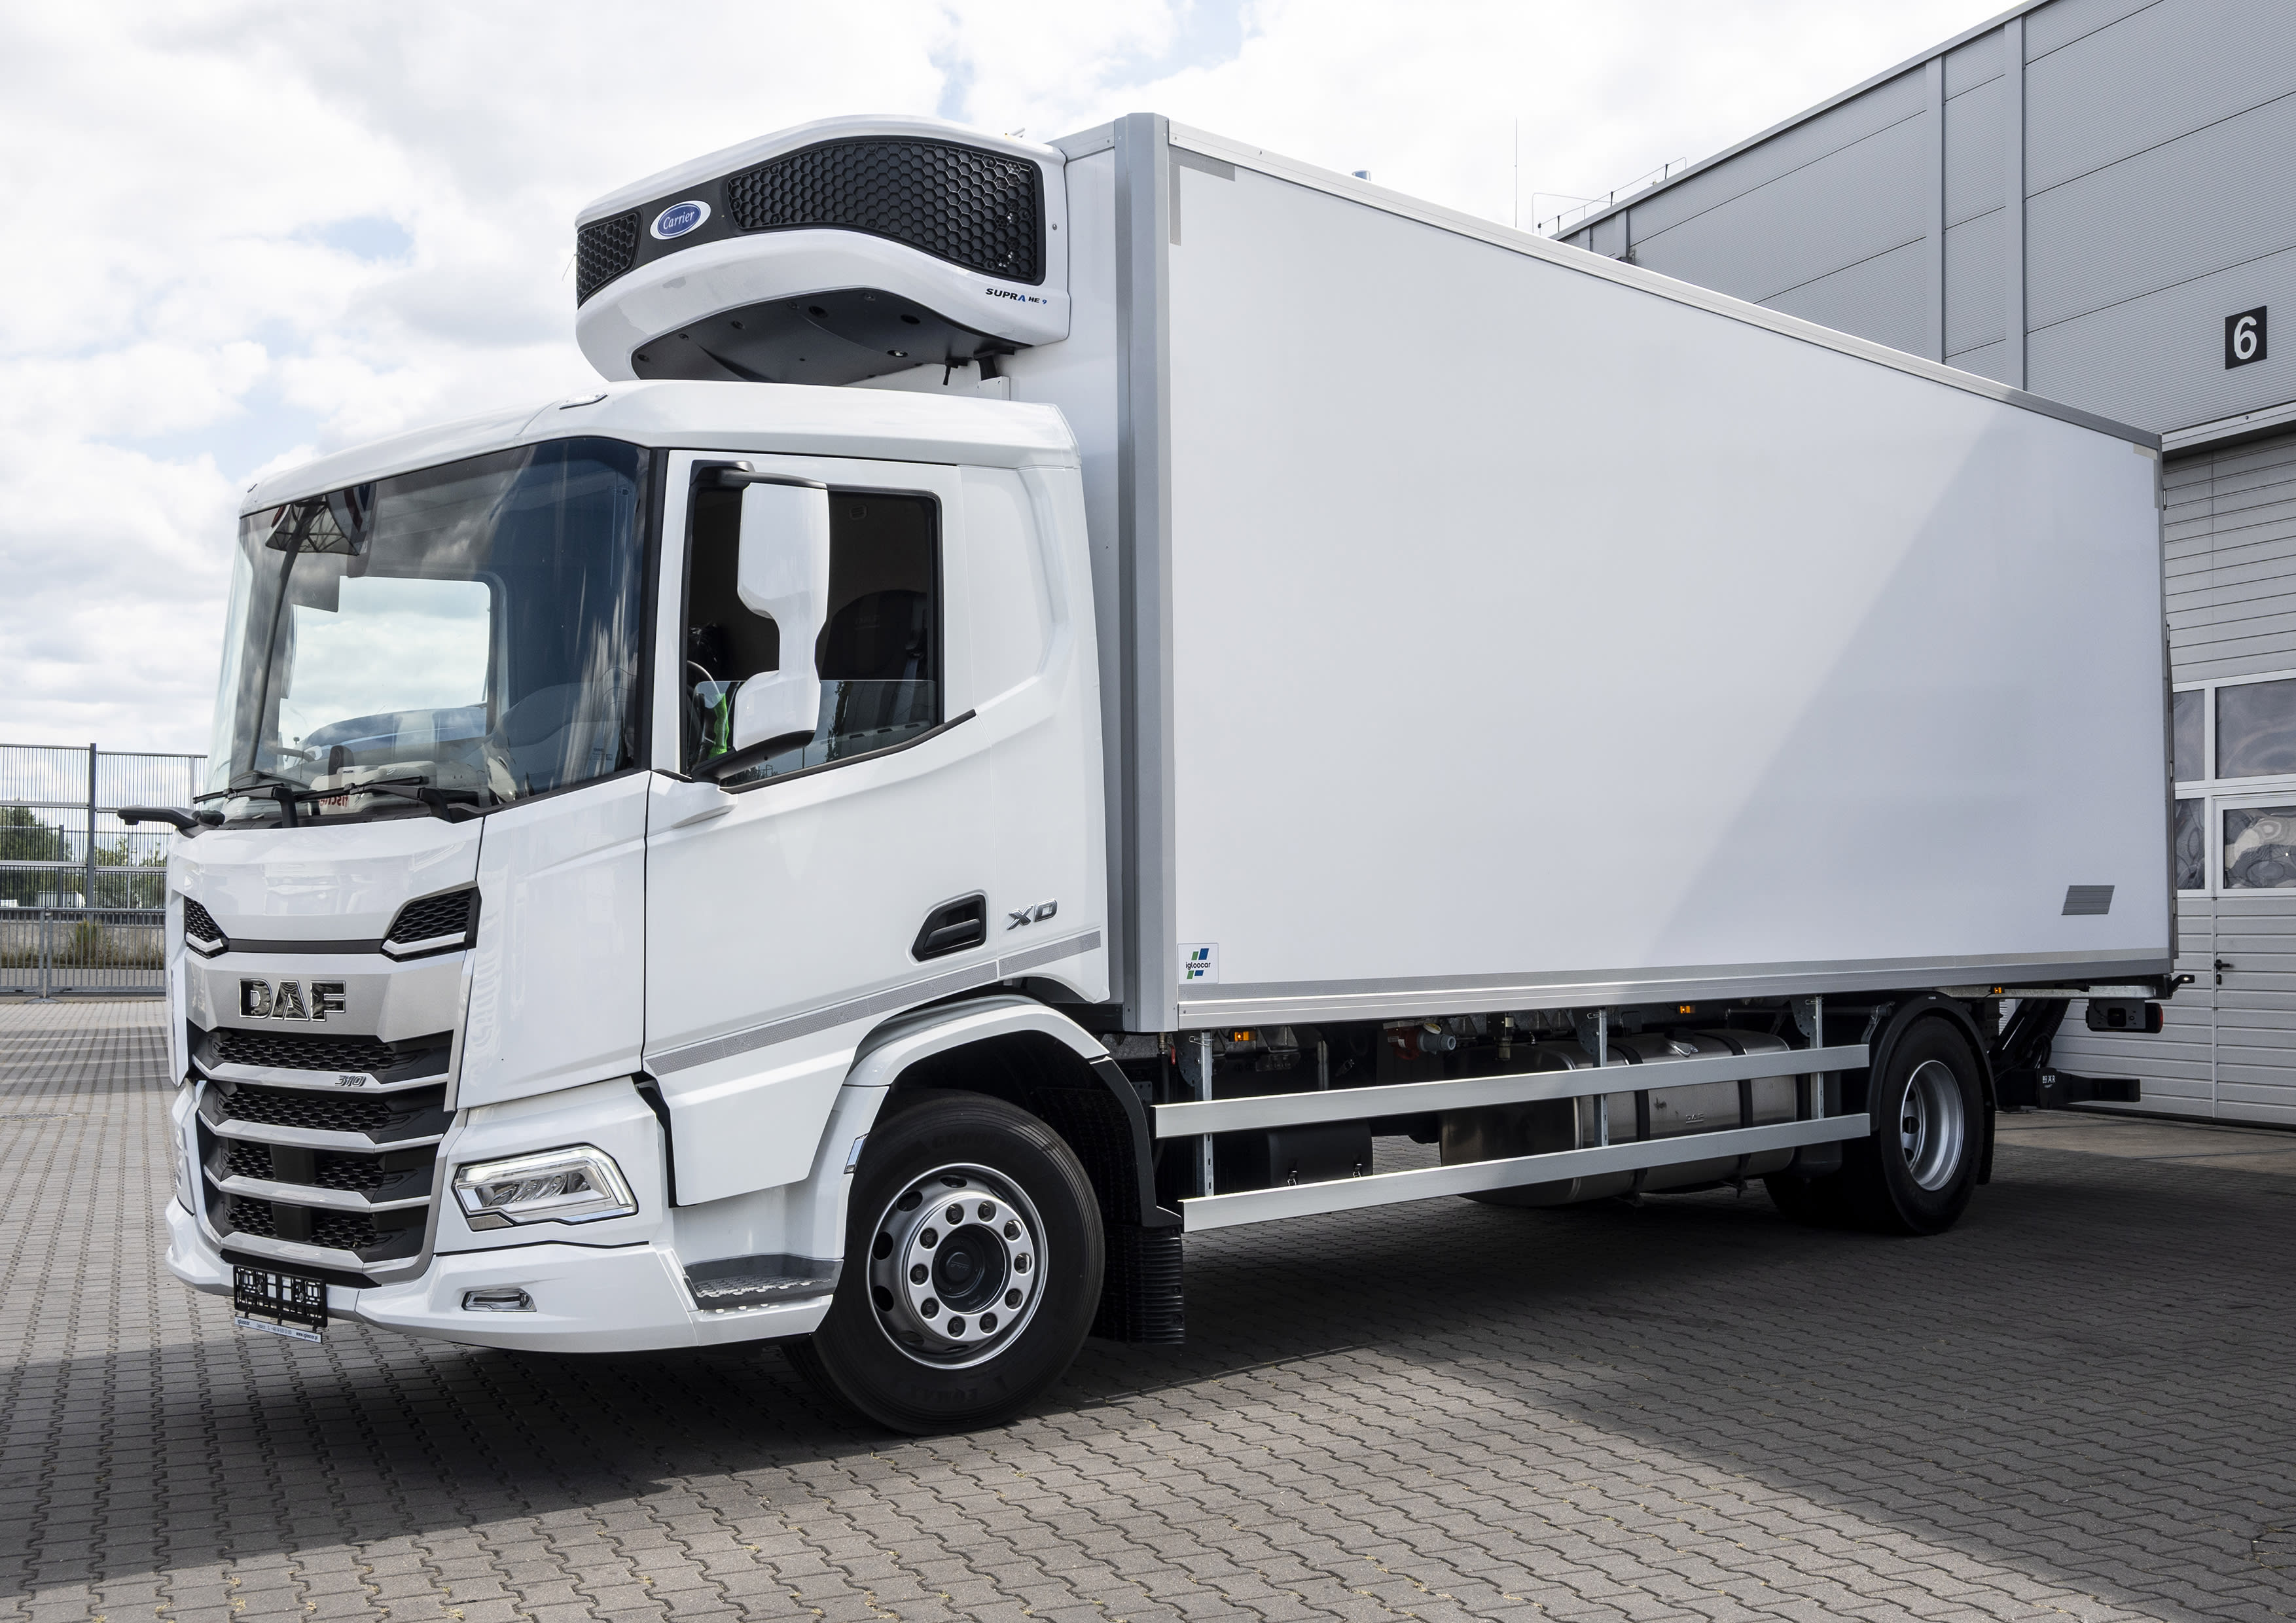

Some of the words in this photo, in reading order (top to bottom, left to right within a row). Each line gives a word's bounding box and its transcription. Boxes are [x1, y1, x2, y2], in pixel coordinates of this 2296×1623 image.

[663, 211, 695, 230] Carrier
[985, 288, 1026, 302] SUPRA
[2233, 315, 2257, 359] 6
[1007, 899, 1058, 930] XD
[1185, 961, 1211, 971] igloocar
[239, 978, 346, 1022] DAF
[335, 1075, 367, 1087] 310
